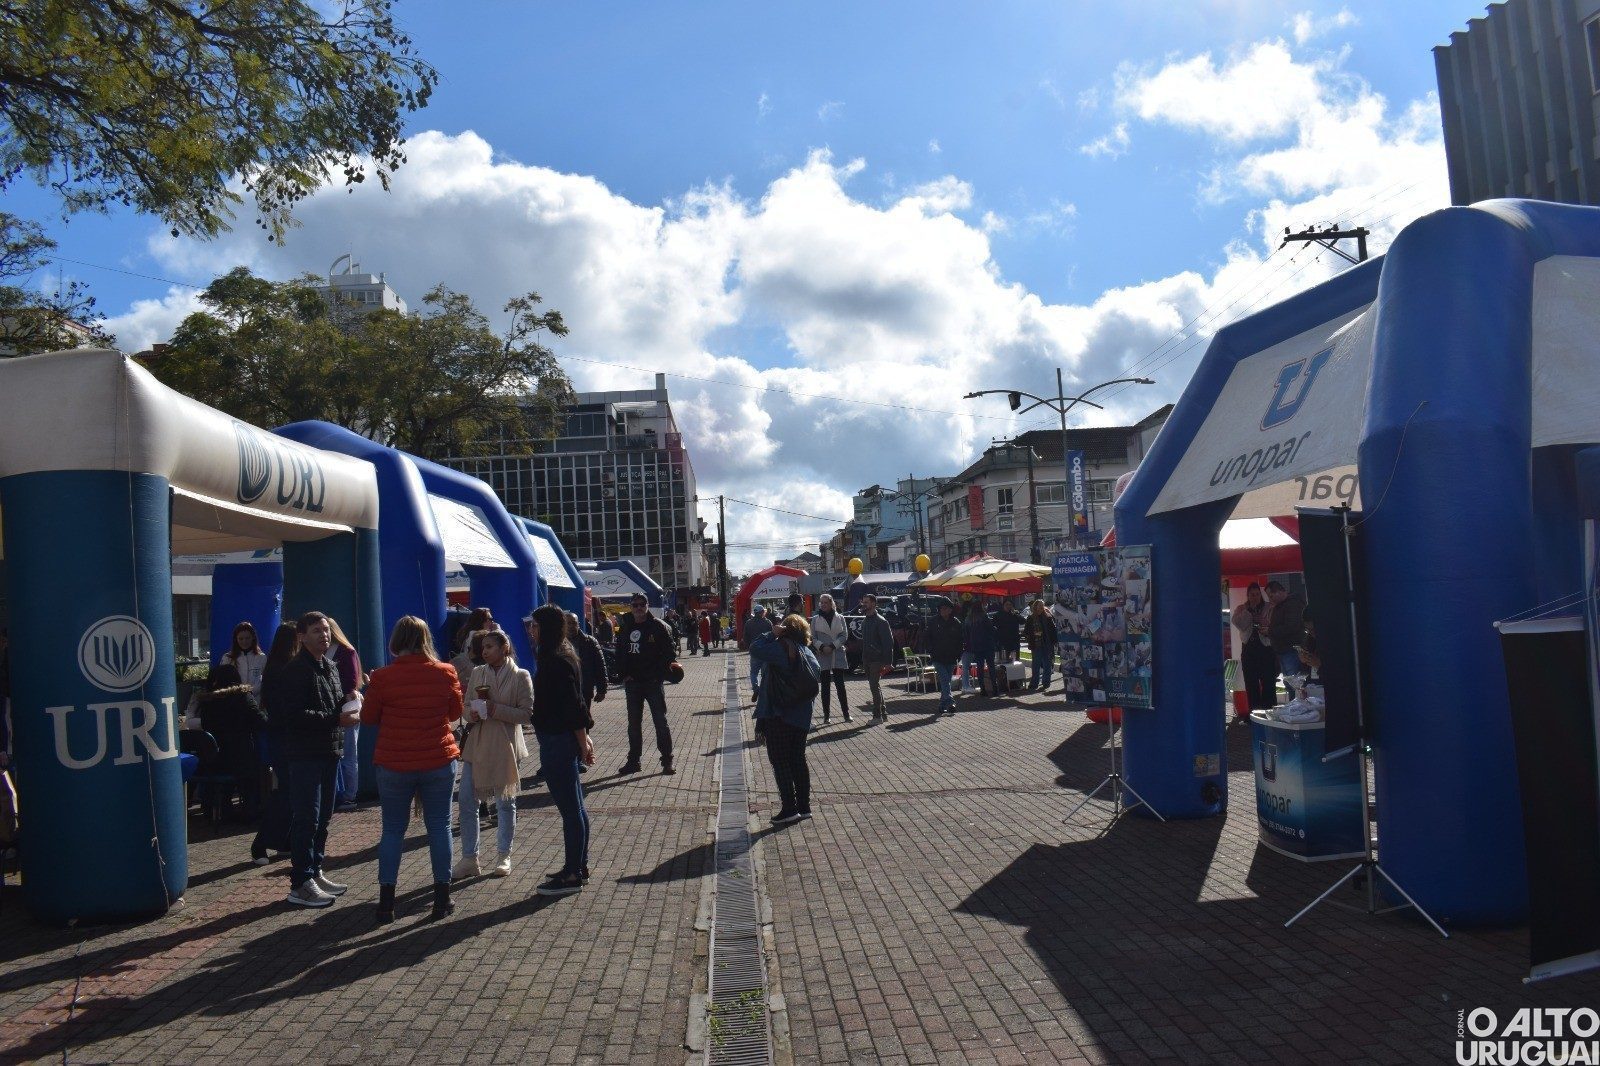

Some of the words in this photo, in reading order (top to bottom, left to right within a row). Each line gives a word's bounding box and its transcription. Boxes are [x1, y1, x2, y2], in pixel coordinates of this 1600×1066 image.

[272, 441, 325, 513] URI
[1072, 456, 1083, 511] Colombo
[1209, 430, 1312, 488] unopar
[1054, 565, 1097, 575] ENFERMAGEM
[1058, 555, 1089, 564] PRÁTICAS
[45, 696, 179, 771] URI
